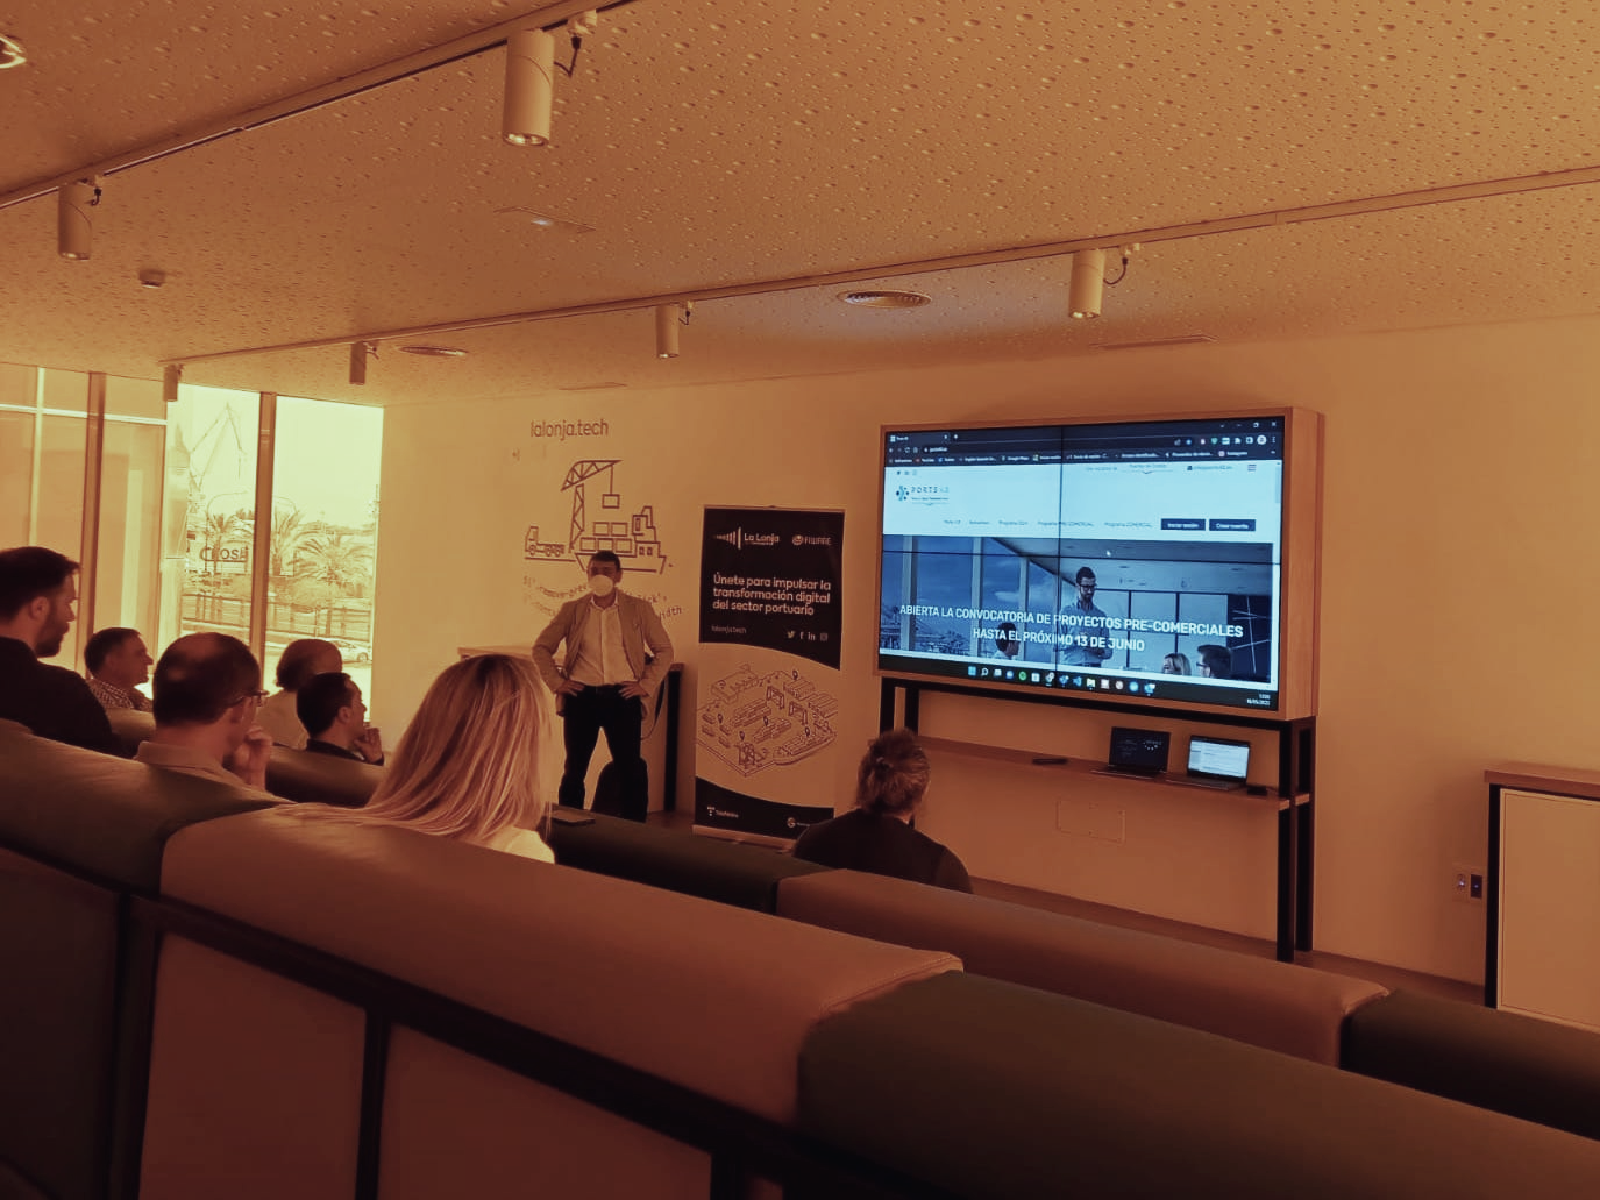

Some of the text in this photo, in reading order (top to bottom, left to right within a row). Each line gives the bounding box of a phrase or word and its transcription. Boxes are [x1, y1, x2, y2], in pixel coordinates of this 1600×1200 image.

[531, 418, 609, 441] lalonja.tech
[713, 572, 832, 591] Únete para impulsar la
[713, 587, 831, 605] transformación digital
[712, 600, 814, 616] del sector portuario
[900, 604, 1244, 638] ABIERTA LA CONVOCATORIA DE PROYECTOS PRE-COMERCIALES
[973, 628, 1145, 651] HASTA EL PRÓXIMO 13 DE JUNIO
